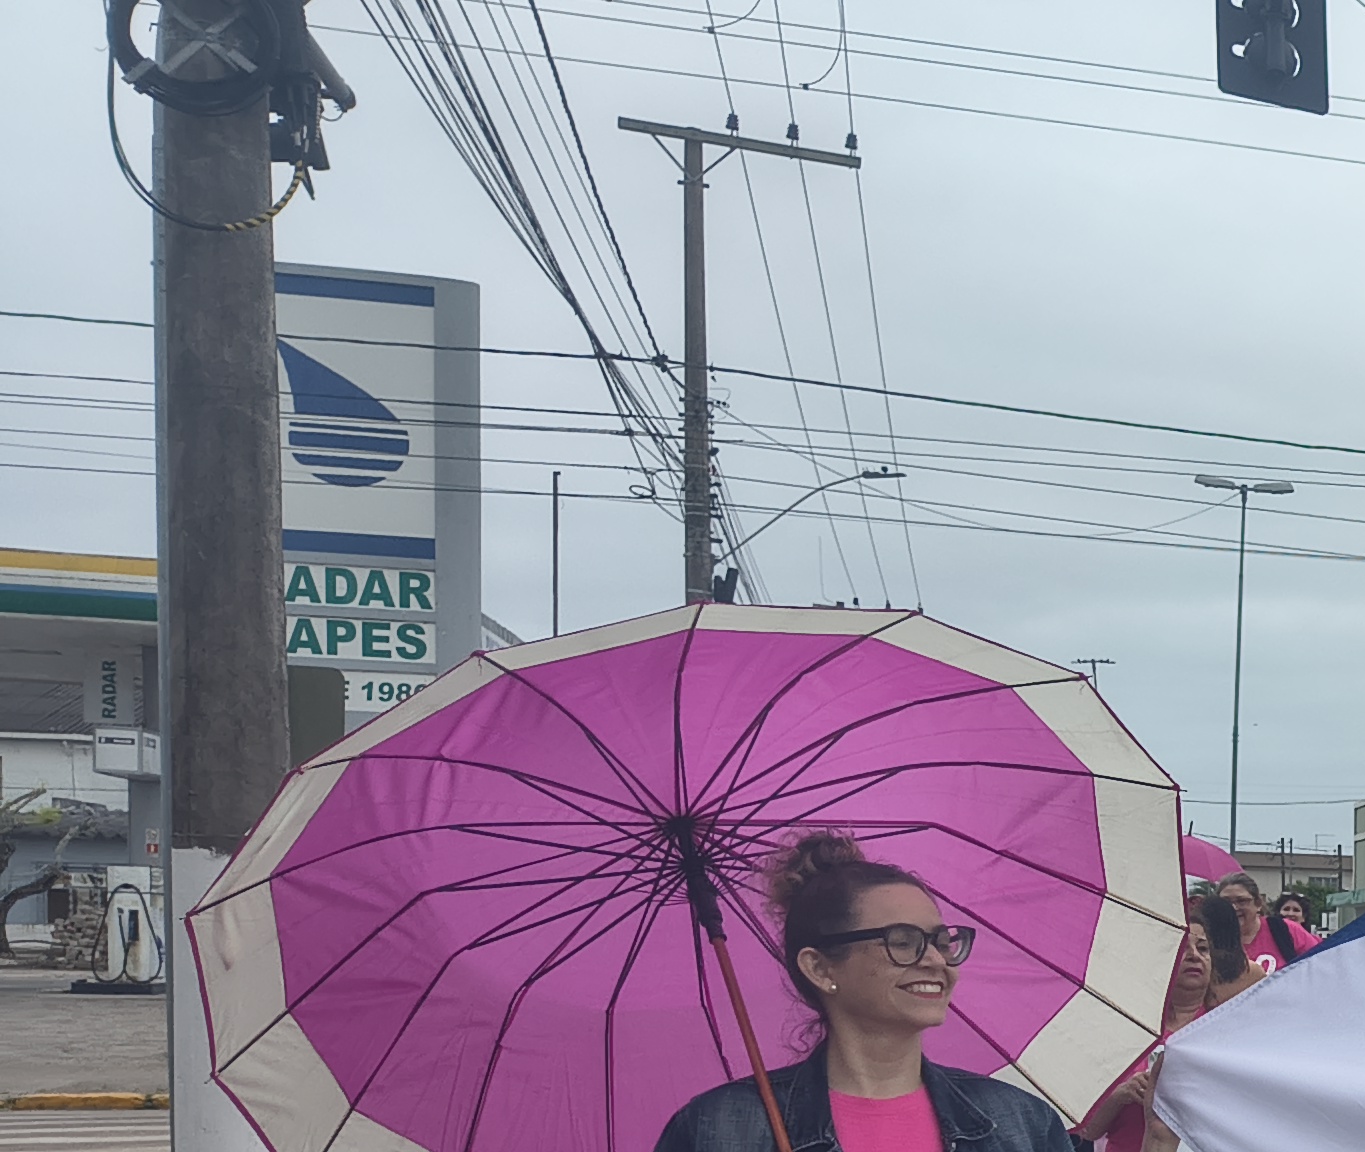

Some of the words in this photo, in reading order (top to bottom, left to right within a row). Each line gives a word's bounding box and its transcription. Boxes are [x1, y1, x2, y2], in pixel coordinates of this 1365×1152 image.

[284, 565, 433, 610] ADAR
[285, 618, 428, 661] APES
[101, 660, 117, 719] RADAR
